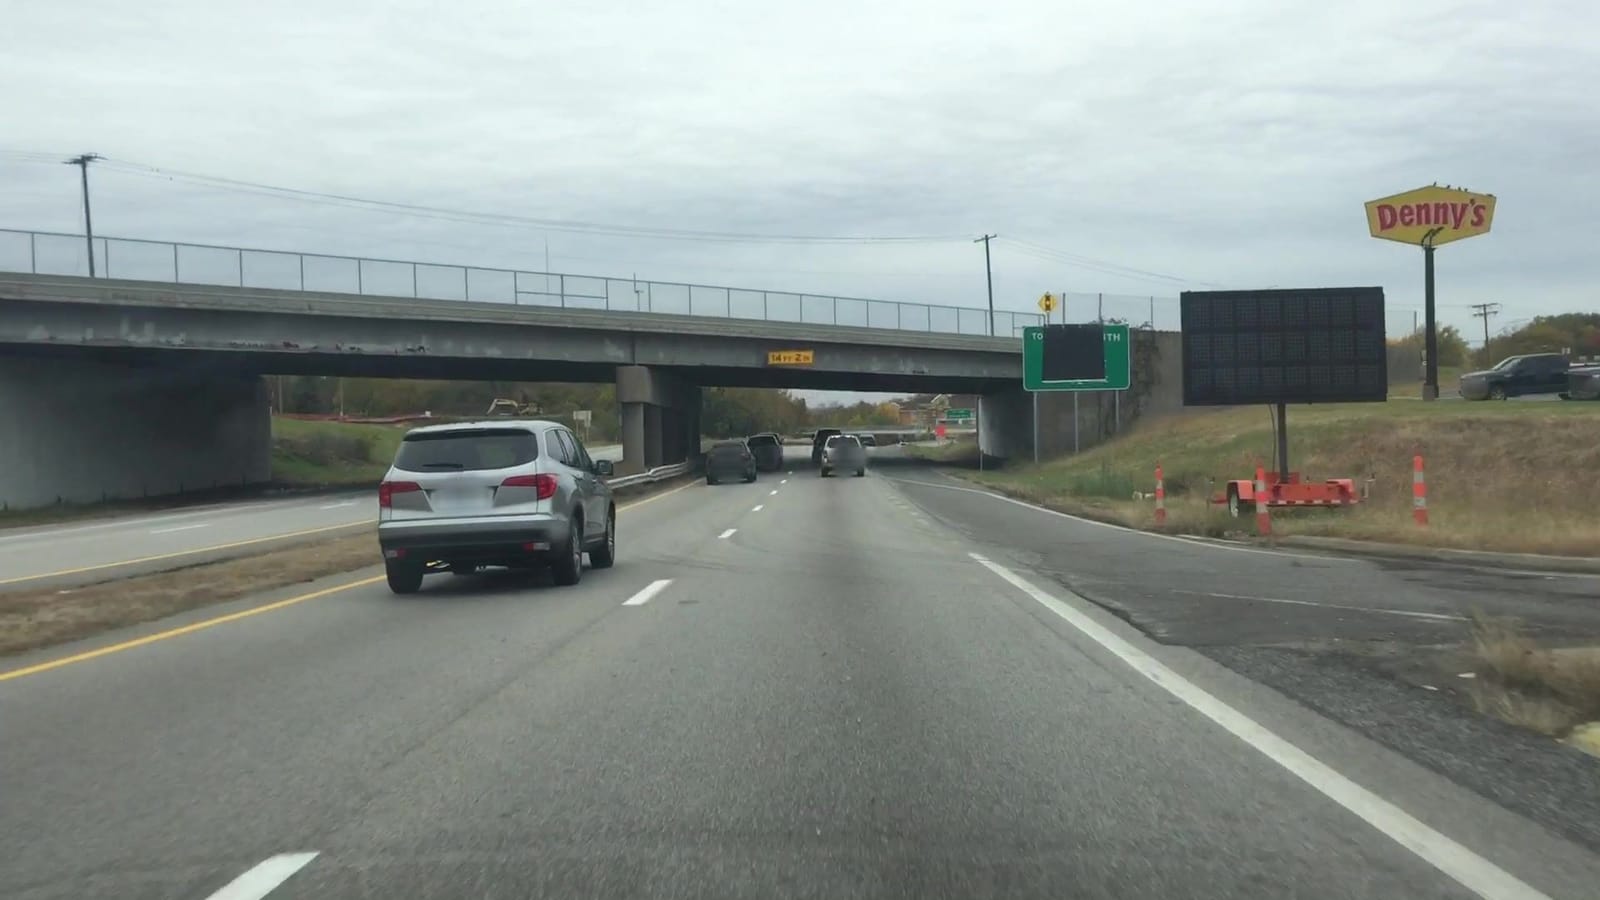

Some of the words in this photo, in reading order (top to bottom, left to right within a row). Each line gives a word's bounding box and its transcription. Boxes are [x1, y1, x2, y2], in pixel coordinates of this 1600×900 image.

[1377, 199, 1486, 231] Denny's
[771, 354, 782, 362] 14
[795, 353, 801, 362] 2
